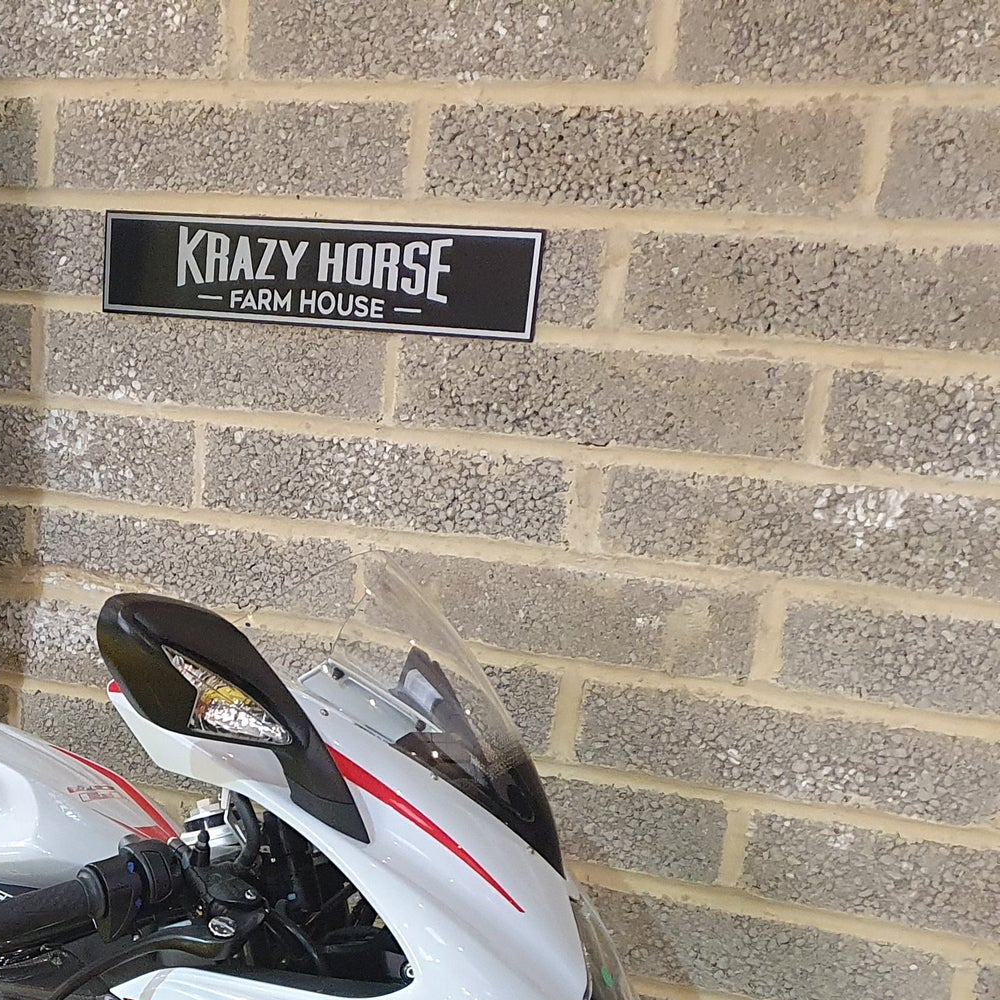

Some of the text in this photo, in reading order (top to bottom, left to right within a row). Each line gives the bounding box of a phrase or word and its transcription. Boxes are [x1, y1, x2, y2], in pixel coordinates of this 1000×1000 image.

[177, 225, 454, 304] KRAZY HORSE
[230, 288, 385, 319] FARM HOUSE
